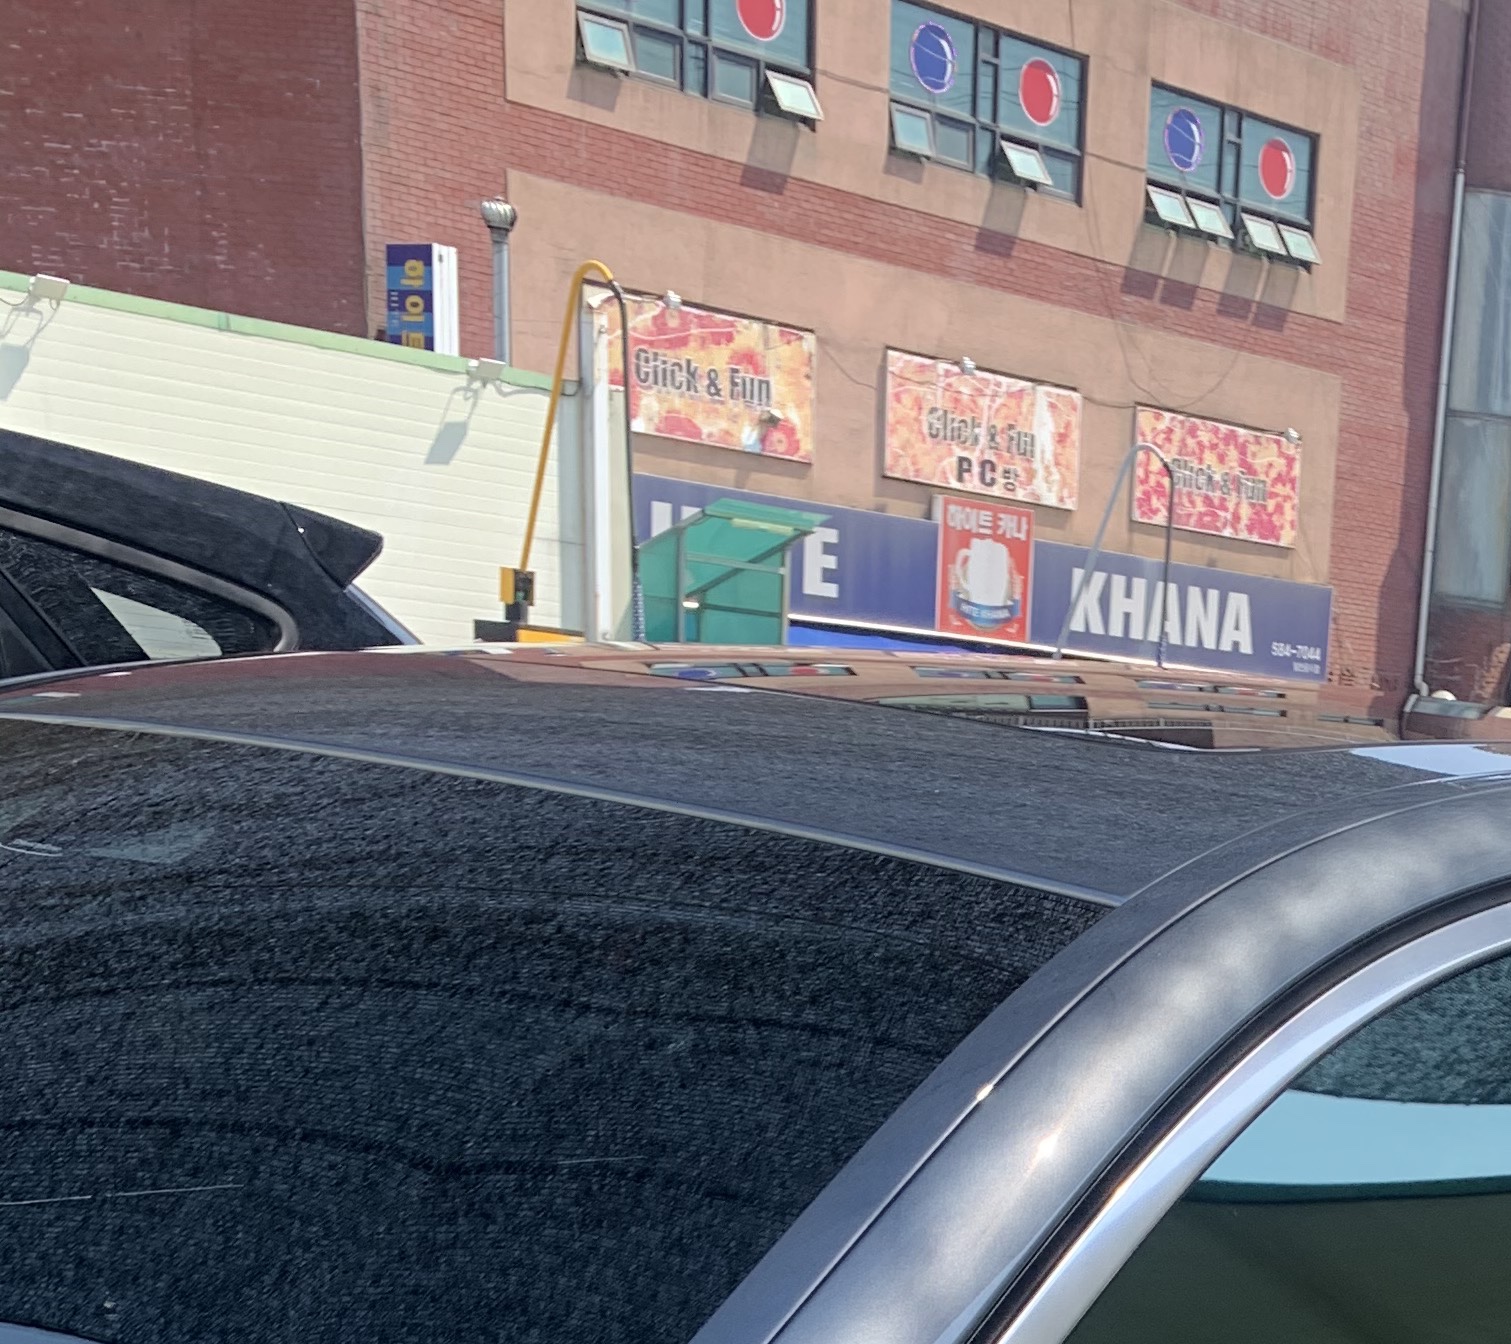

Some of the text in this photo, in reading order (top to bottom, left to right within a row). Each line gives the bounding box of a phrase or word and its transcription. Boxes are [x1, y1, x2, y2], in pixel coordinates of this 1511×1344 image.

[633, 347, 699, 394] Click
[705, 367, 723, 397] &
[1069, 567, 1253, 655] KHANA
